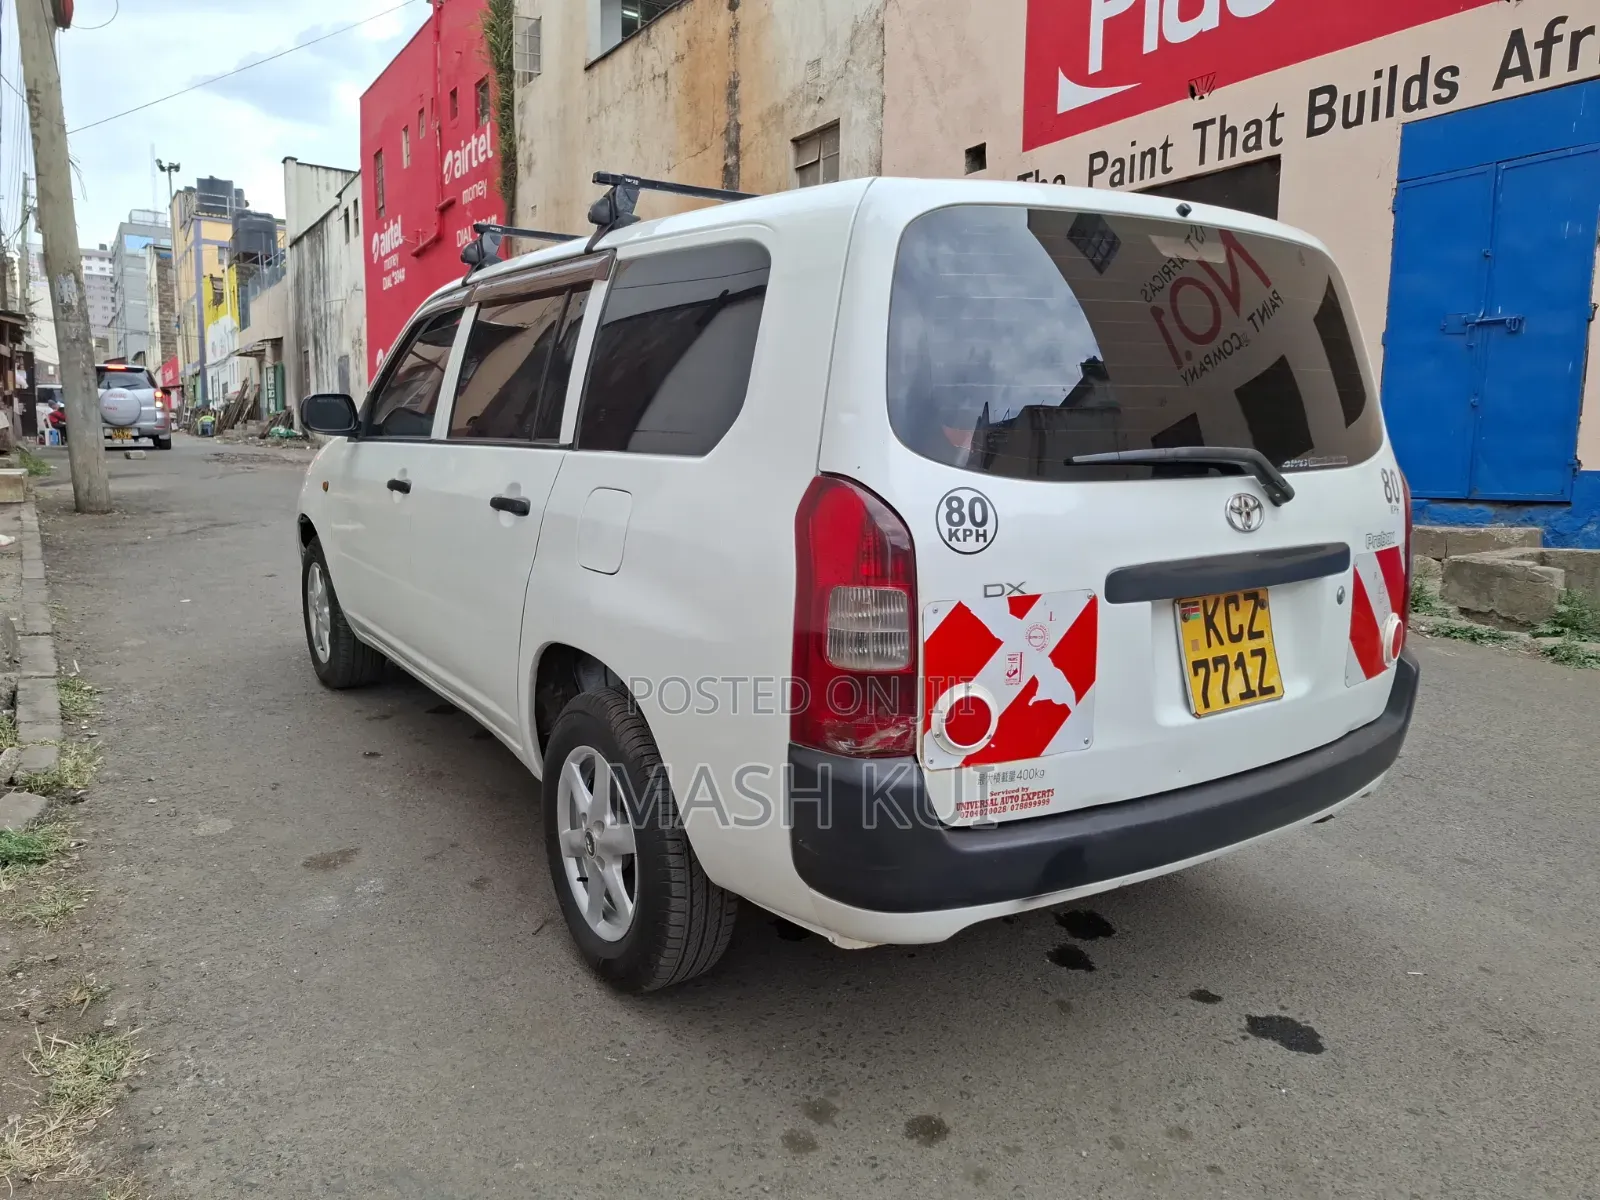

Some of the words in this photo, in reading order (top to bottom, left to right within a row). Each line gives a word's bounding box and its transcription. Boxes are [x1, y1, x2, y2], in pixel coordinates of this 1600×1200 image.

[1088, 0, 1276, 75] Pla
[1088, 135, 1174, 189] Paint
[1193, 102, 1285, 166] That
[1305, 55, 1460, 138] Builds
[1492, 15, 1600, 91] Afr
[454, 121, 493, 178] airtel
[462, 178, 488, 205] money
[380, 214, 403, 257] airtel
[456, 225, 472, 247] DIAL
[1381, 467, 1400, 504] 80
[945, 495, 989, 529] 80
[947, 527, 988, 543] KPH
[983, 581, 1027, 598] DX
[1202, 592, 1265, 649] KCZ
[1191, 647, 1276, 709] 771Z
[956, 798, 998, 811] UNIVERSAL
[1000, 794, 1020, 805] AUTO
[1021, 788, 1055, 802] EXPERTS
[989, 788, 1020, 797] Serviced
